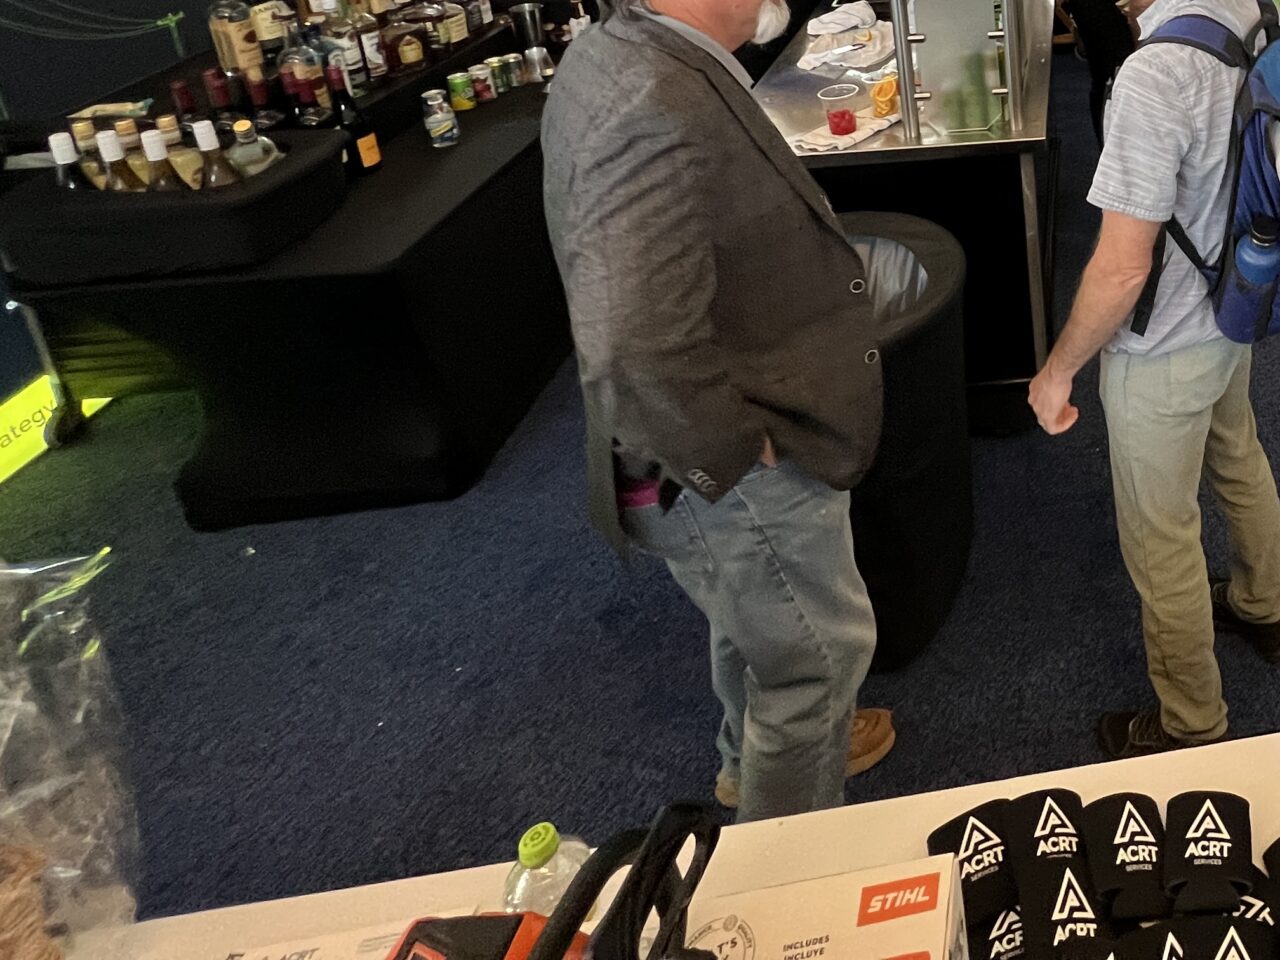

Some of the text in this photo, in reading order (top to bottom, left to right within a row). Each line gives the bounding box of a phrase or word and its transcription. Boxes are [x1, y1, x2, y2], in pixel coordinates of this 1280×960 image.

[1037, 837, 1079, 856] ACRT
[1116, 845, 1158, 865] ACRT
[1184, 841, 1232, 858] ACRT
[961, 846, 1005, 880] ACRT
[1125, 863, 1153, 872] SERVICES
[970, 865, 999, 882] SERVICES
[867, 886, 930, 913] STIHL
[783, 934, 830, 952] INCLUDES
[784, 946, 825, 960] INCLUYE
